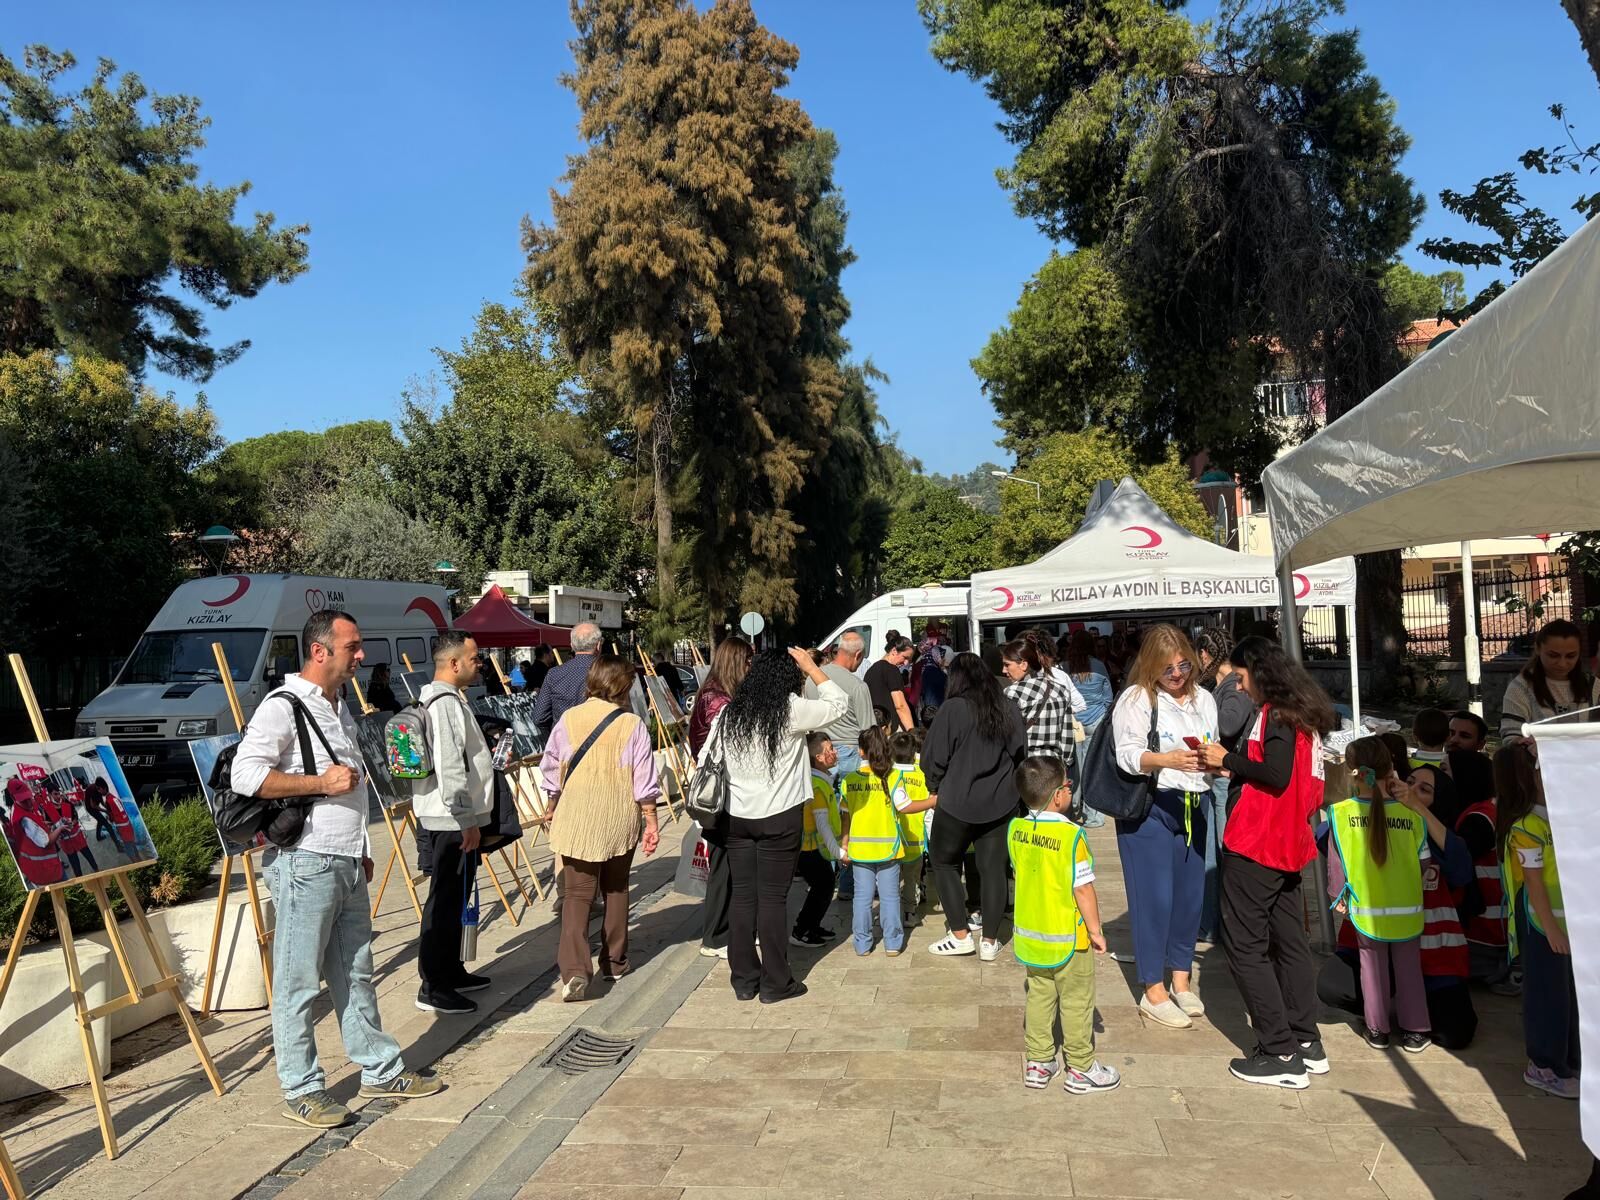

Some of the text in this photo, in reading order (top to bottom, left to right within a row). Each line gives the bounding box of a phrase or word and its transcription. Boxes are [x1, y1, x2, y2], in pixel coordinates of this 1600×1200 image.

[1051, 575, 1275, 602] KIZILAY AYDIN İL BAŞKANLIĞI
[326, 590, 345, 602] KAN
[1016, 594, 1041, 602] KIZILAY
[186, 614, 233, 625] KIZILAY
[1031, 833, 1062, 852] ANAOKULU
